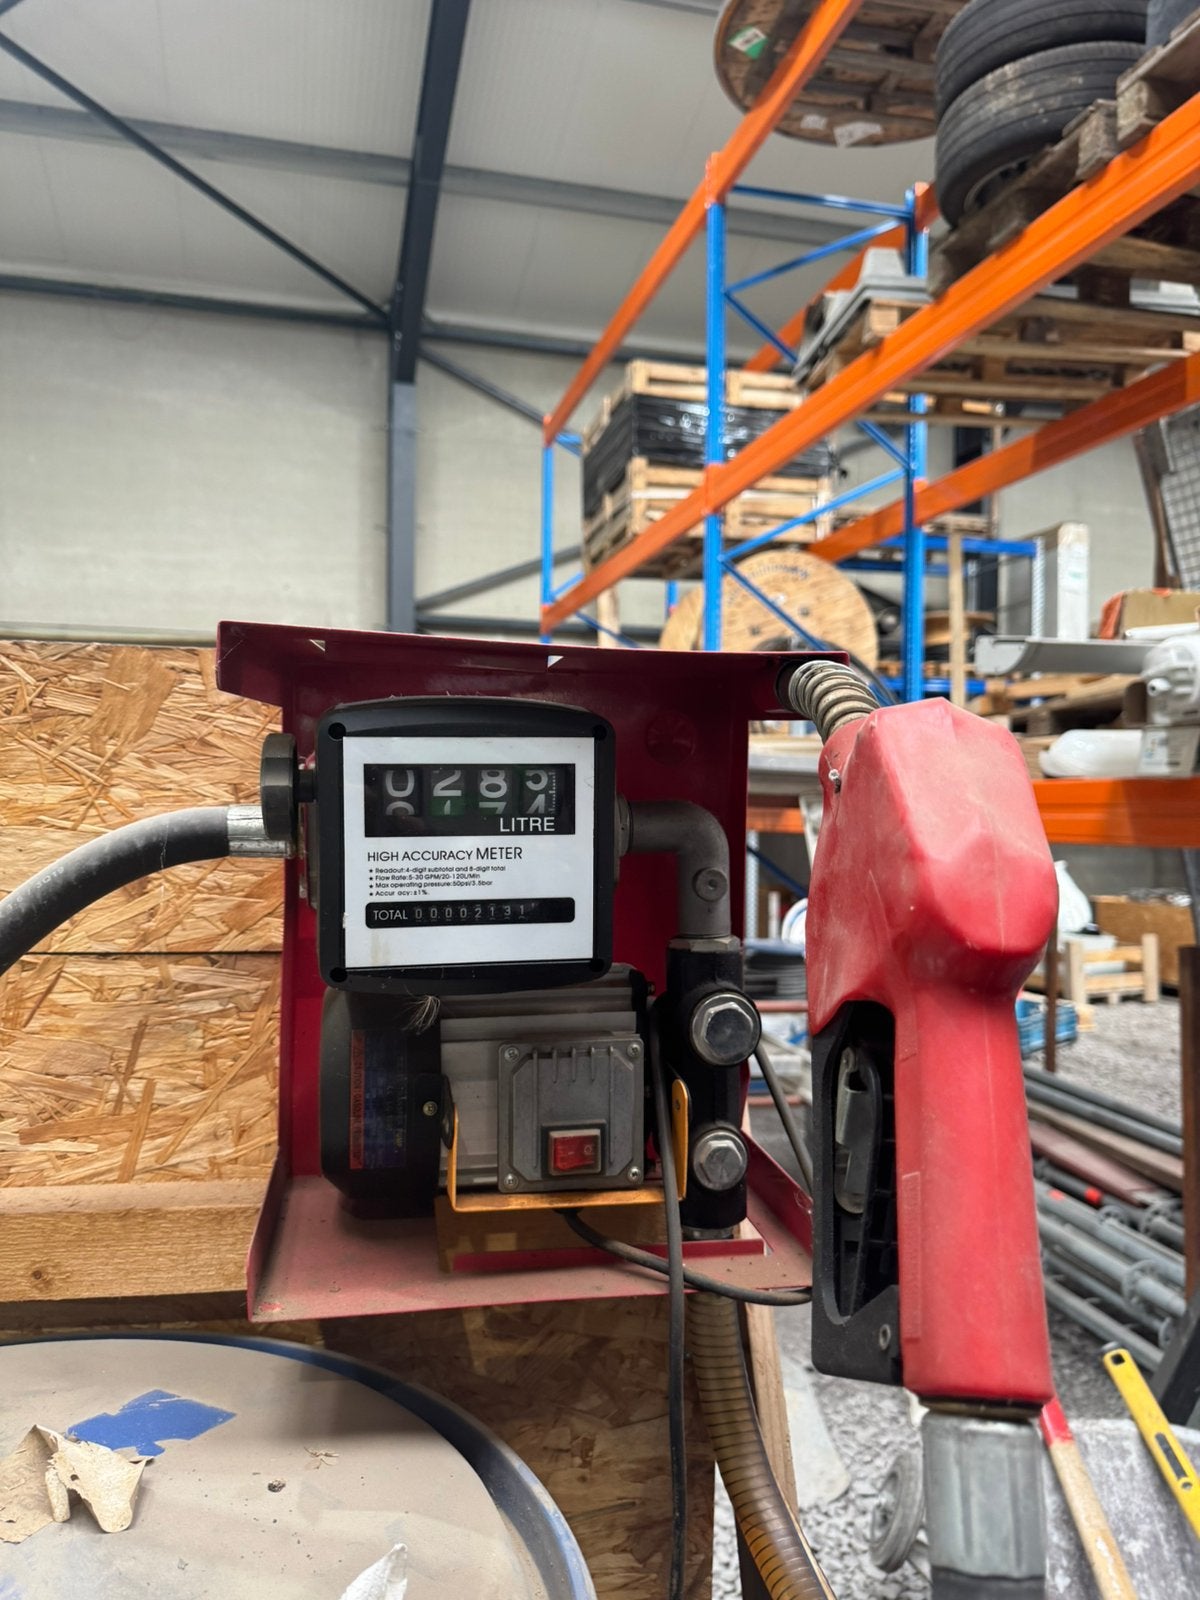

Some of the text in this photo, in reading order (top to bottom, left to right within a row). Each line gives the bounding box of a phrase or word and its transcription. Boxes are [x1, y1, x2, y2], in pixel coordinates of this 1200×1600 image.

[500, 817, 556, 832] LITRE
[367, 846, 523, 862] HIGH ACCURACY METER
[390, 881, 423, 889] operating
[373, 909, 408, 921] TOTAL
